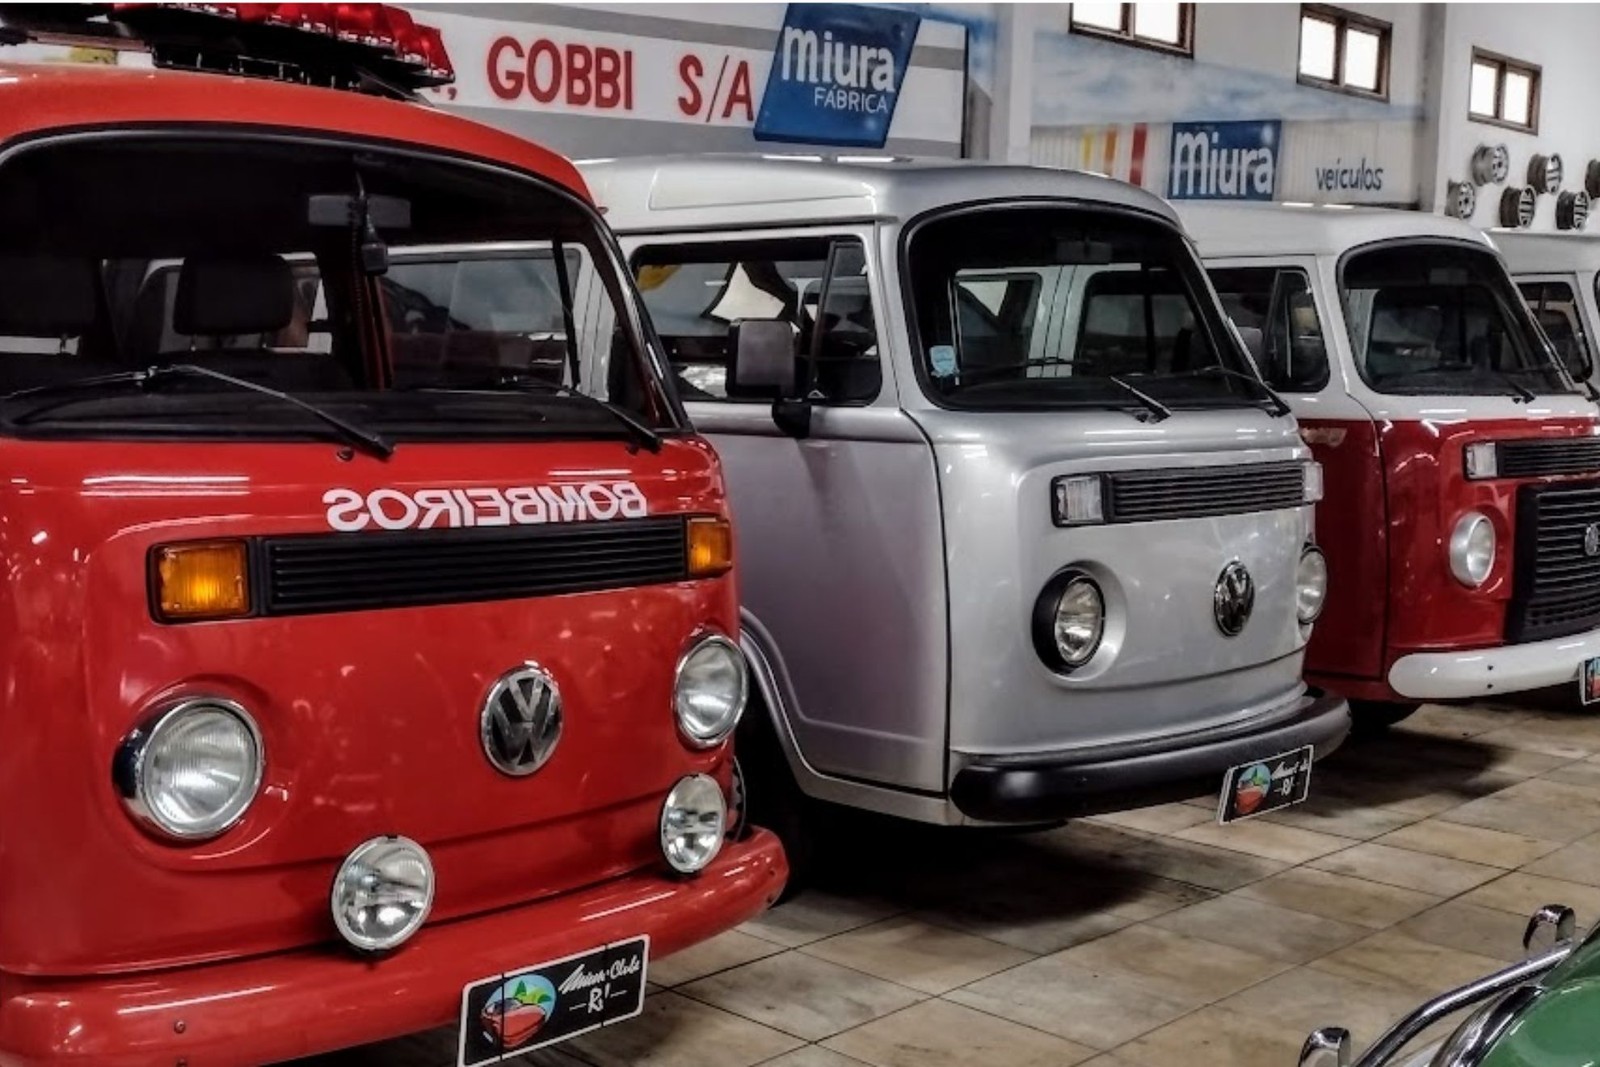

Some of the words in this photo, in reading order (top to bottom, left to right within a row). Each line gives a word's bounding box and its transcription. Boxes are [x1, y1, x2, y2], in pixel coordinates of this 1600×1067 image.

[487, 36, 633, 110] GOBBI
[678, 54, 754, 123] S/A
[814, 84, 888, 114] FÁBRICA
[1316, 157, 1384, 191] veículos
